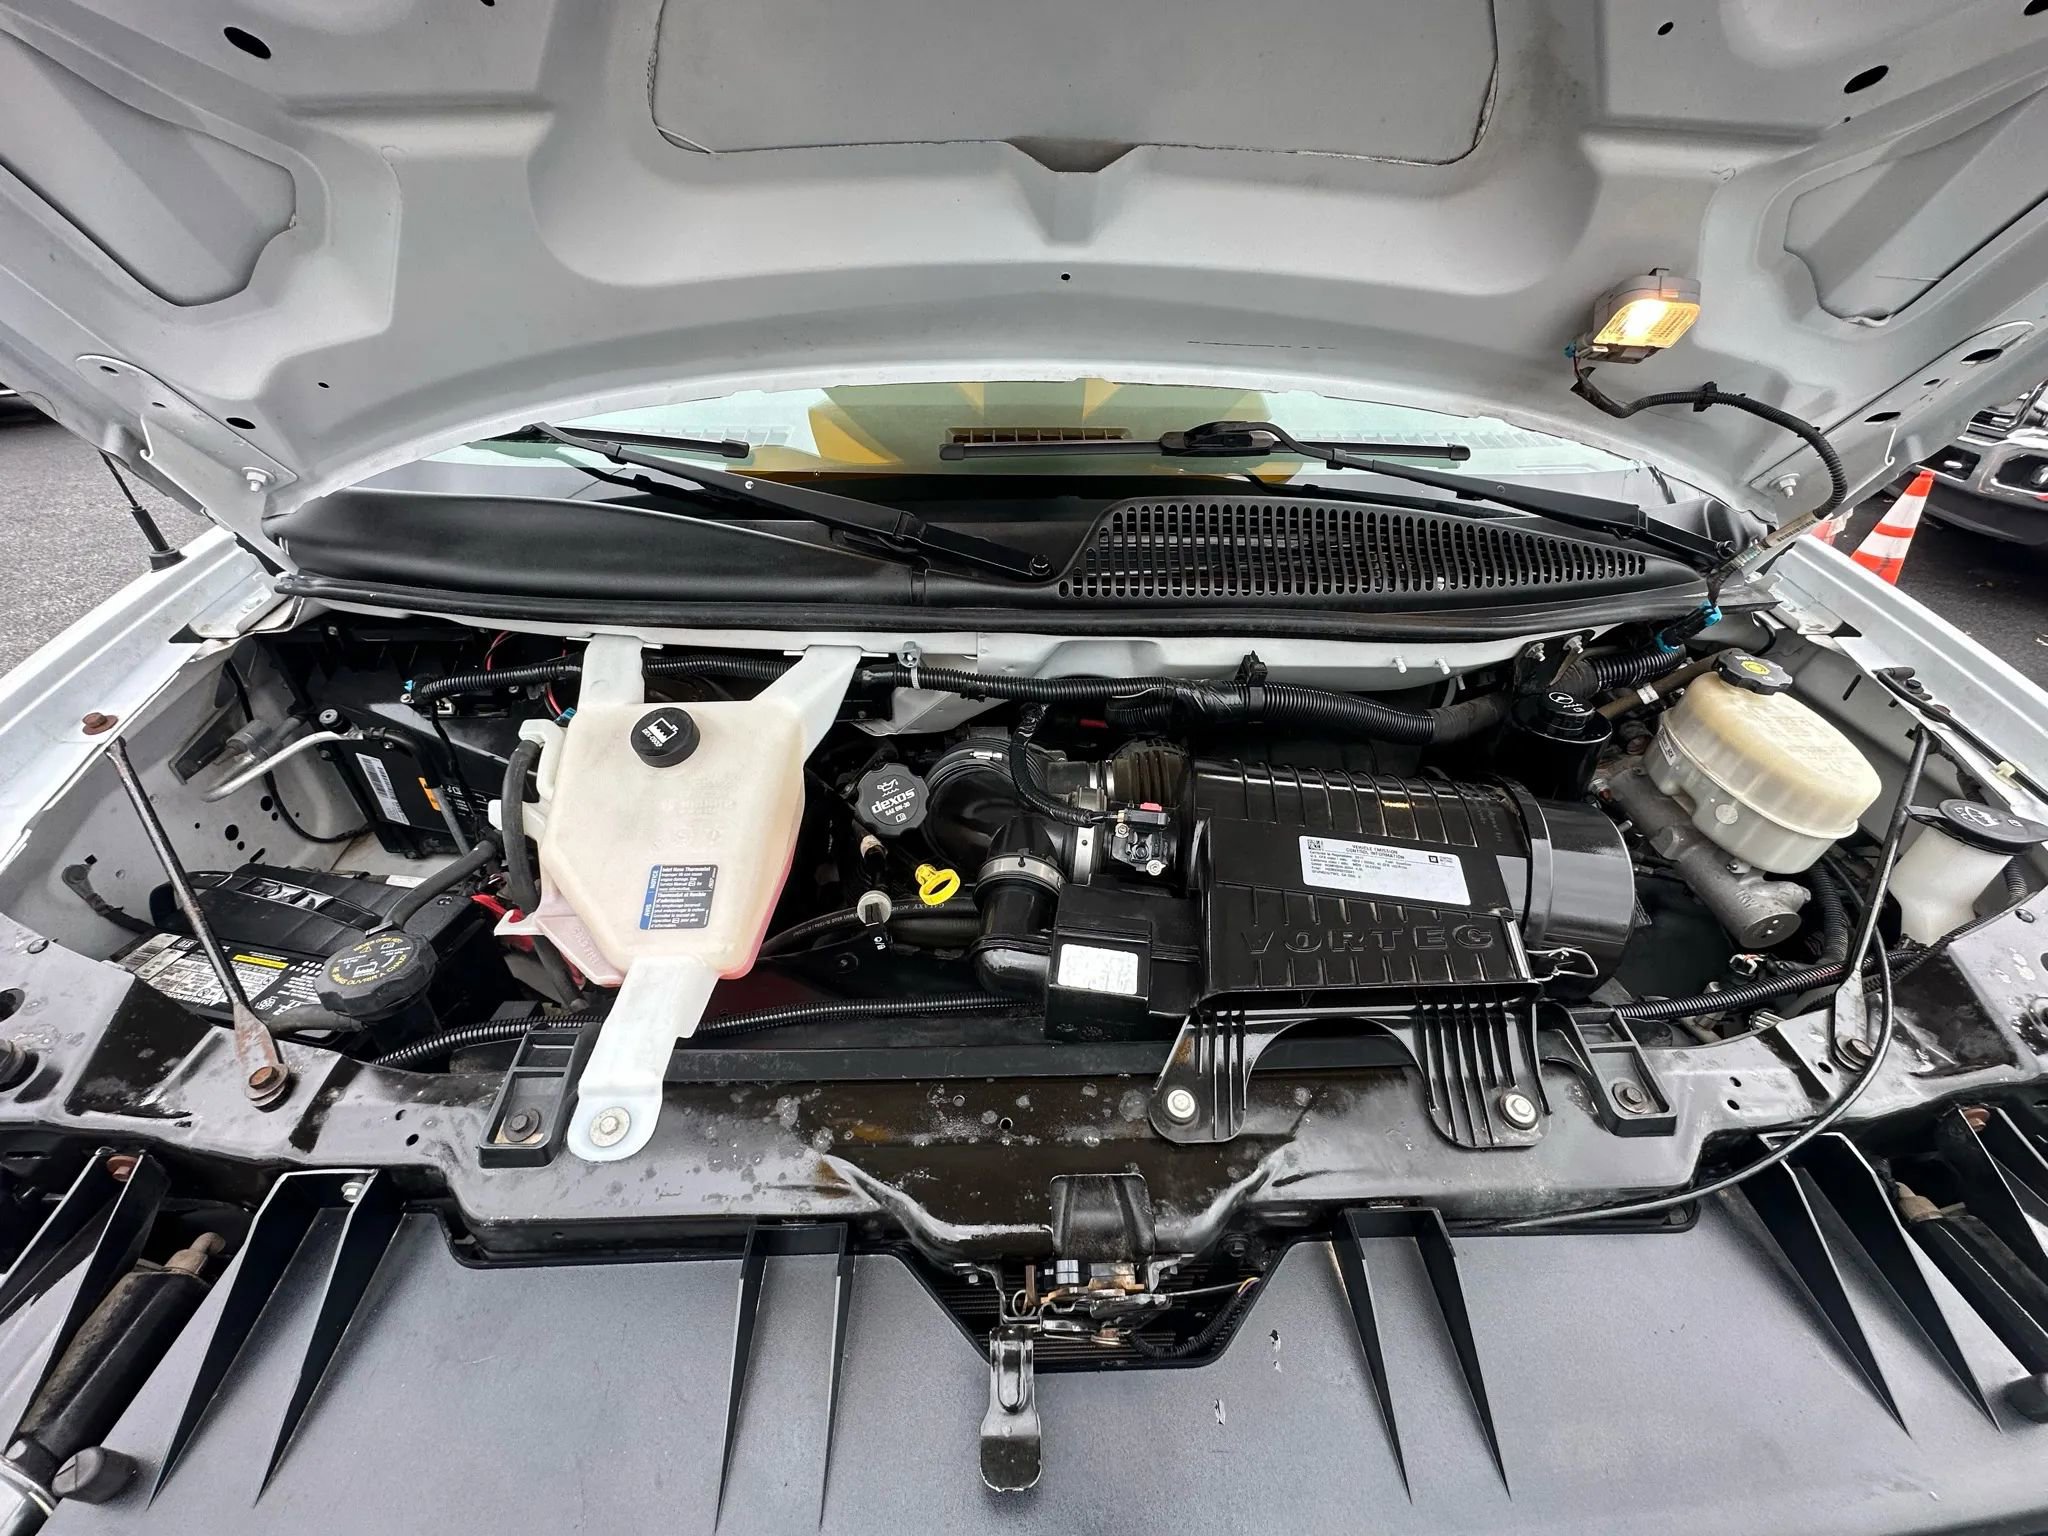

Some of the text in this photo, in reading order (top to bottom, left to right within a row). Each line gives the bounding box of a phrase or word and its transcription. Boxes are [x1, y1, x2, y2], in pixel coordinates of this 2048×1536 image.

[871, 788, 915, 814] dexos
[1371, 851, 1404, 859] INFORMATION
[1374, 847, 1398, 855] EMISSION
[649, 870, 659, 889] NOTICE
[644, 903, 652, 917] AVIS
[347, 974, 378, 986] OUVRIR
